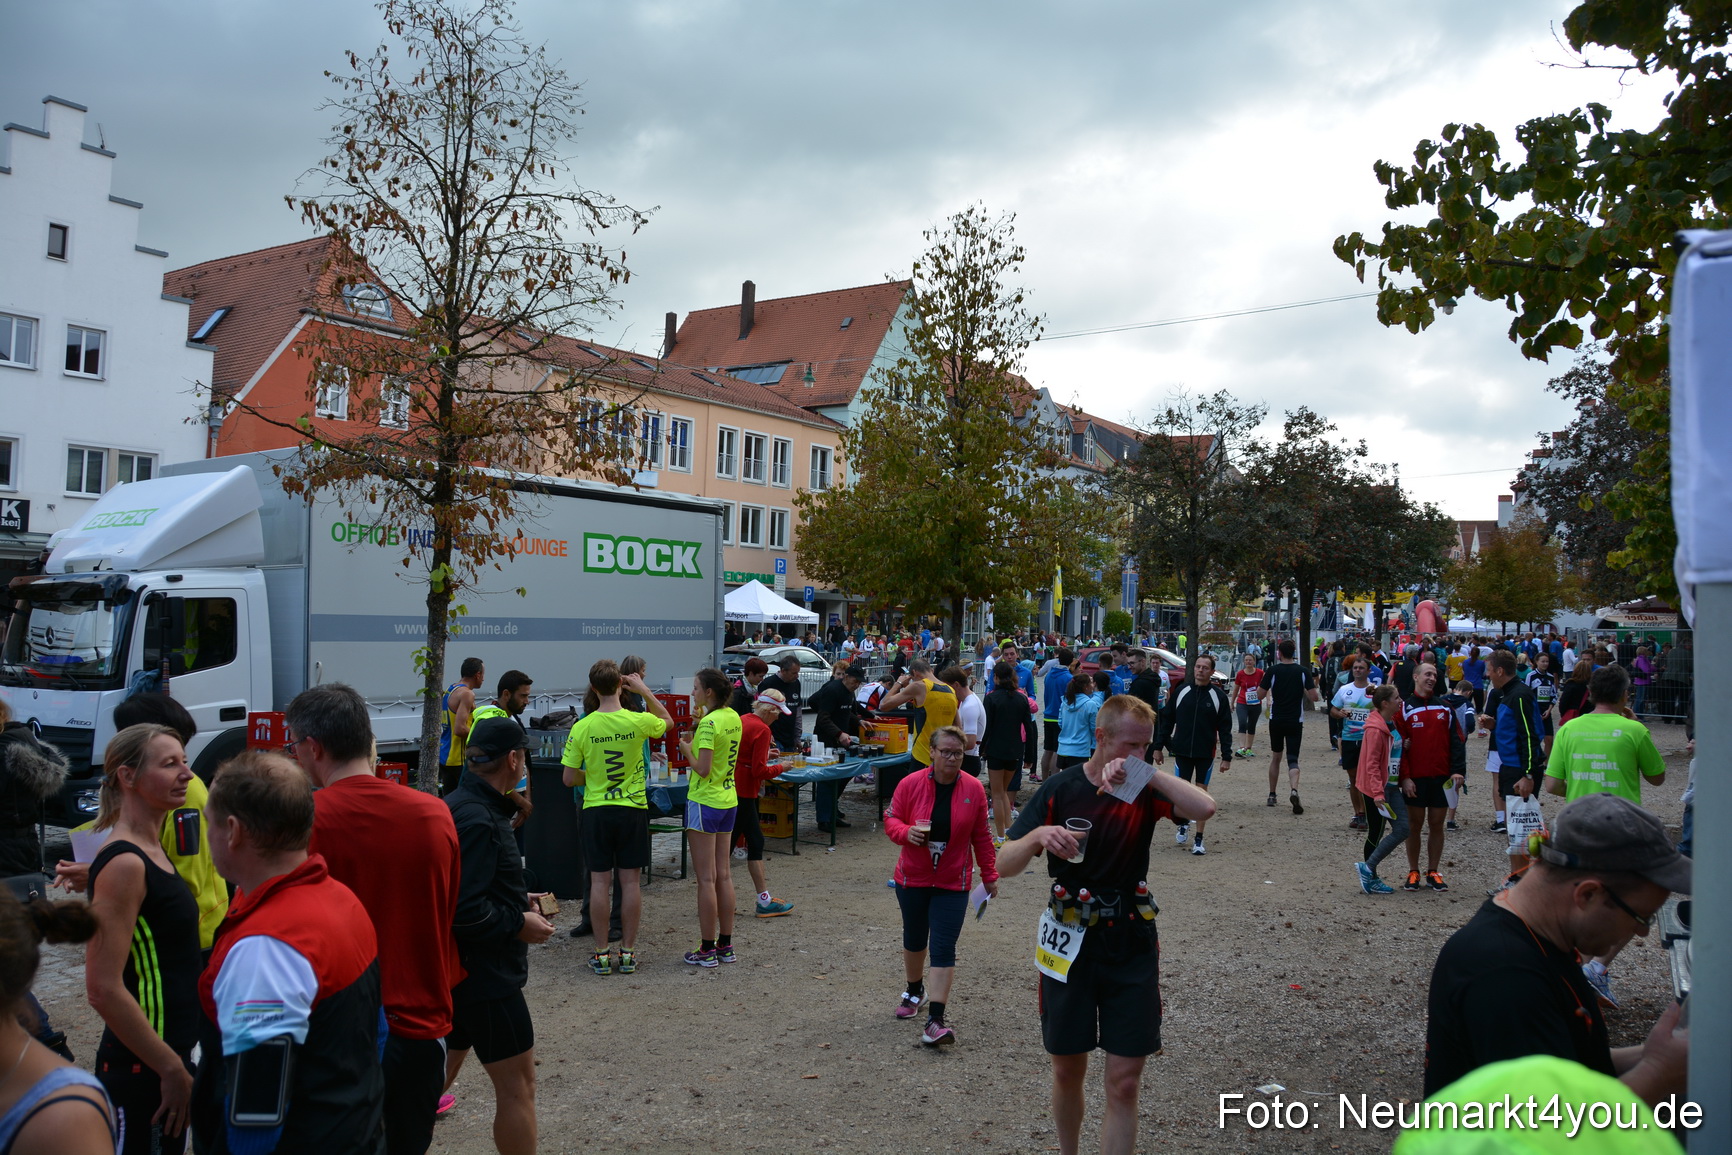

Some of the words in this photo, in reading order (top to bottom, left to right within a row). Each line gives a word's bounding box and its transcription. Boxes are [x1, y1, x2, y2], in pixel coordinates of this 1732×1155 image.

[81, 508, 159, 531] BOCK
[331, 522, 398, 545] OFFICE
[504, 535, 568, 557] LOUNGE
[585, 534, 701, 577] BOCK
[582, 622, 621, 637] inspired
[623, 623, 635, 638] by
[637, 624, 663, 636] smart
[665, 624, 704, 637] concepts
[589, 736, 613, 744] Team
[614, 731, 635, 741] Partl
[603, 749, 625, 800] BMW
[1041, 922, 1071, 956] 342
[1042, 954, 1055, 968] Nils
